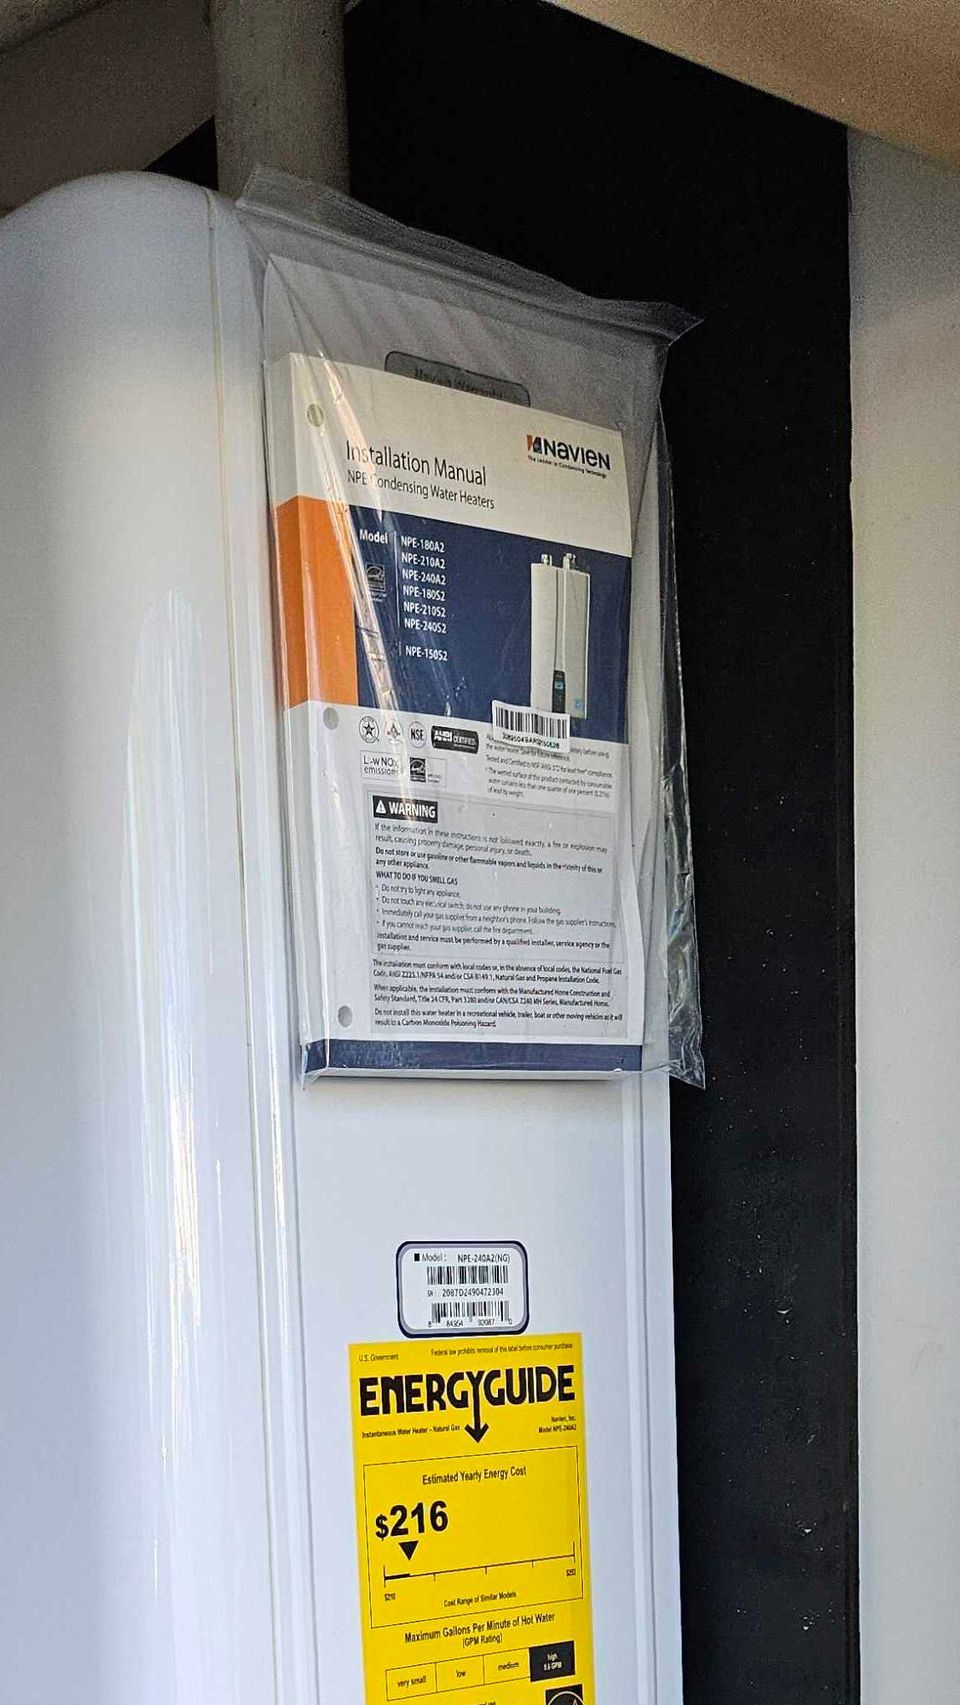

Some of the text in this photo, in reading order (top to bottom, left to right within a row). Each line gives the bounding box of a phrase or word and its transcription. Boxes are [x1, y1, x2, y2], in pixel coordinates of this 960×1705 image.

[347, 441, 486, 486] Installation Manual
[348, 470, 367, 485] NPE
[431, 484, 456, 502] Water
[460, 490, 494, 509] Heaters
[360, 529, 444, 552] Model NPE-180A2
[402, 552, 445, 569] NPE-210A2
[402, 569, 446, 585] NPE-240A2
[403, 585, 445, 601] NPE-180S2
[404, 601, 446, 617] NPE-210S2
[405, 618, 446, 633] NPE-240S2
[406, 645, 448, 661] NPE-150S2
[363, 756, 380, 766] Lw
[389, 801, 435, 818] WARNING
[458, 1254, 510, 1263] NPE-240A2(NG)
[359, 1365, 575, 1416] ENERGYGUIDE
[362, 1430, 396, 1438] Instantaneous
[422, 1466, 526, 1485] Estimated Yearly Energy Cost
[375, 1500, 448, 1540] $216
[457, 1597, 473, 1606] Range
[481, 1593, 497, 1602] Similar
[499, 1591, 516, 1600] Models
[405, 1613, 555, 1643] Maximum Gallons Per Minute of Hot Water
[463, 1633, 502, 1648] (GPM Rating)
[456, 1670, 465, 1678] low
[498, 1662, 519, 1671] medium
[397, 1675, 426, 1688] very small
